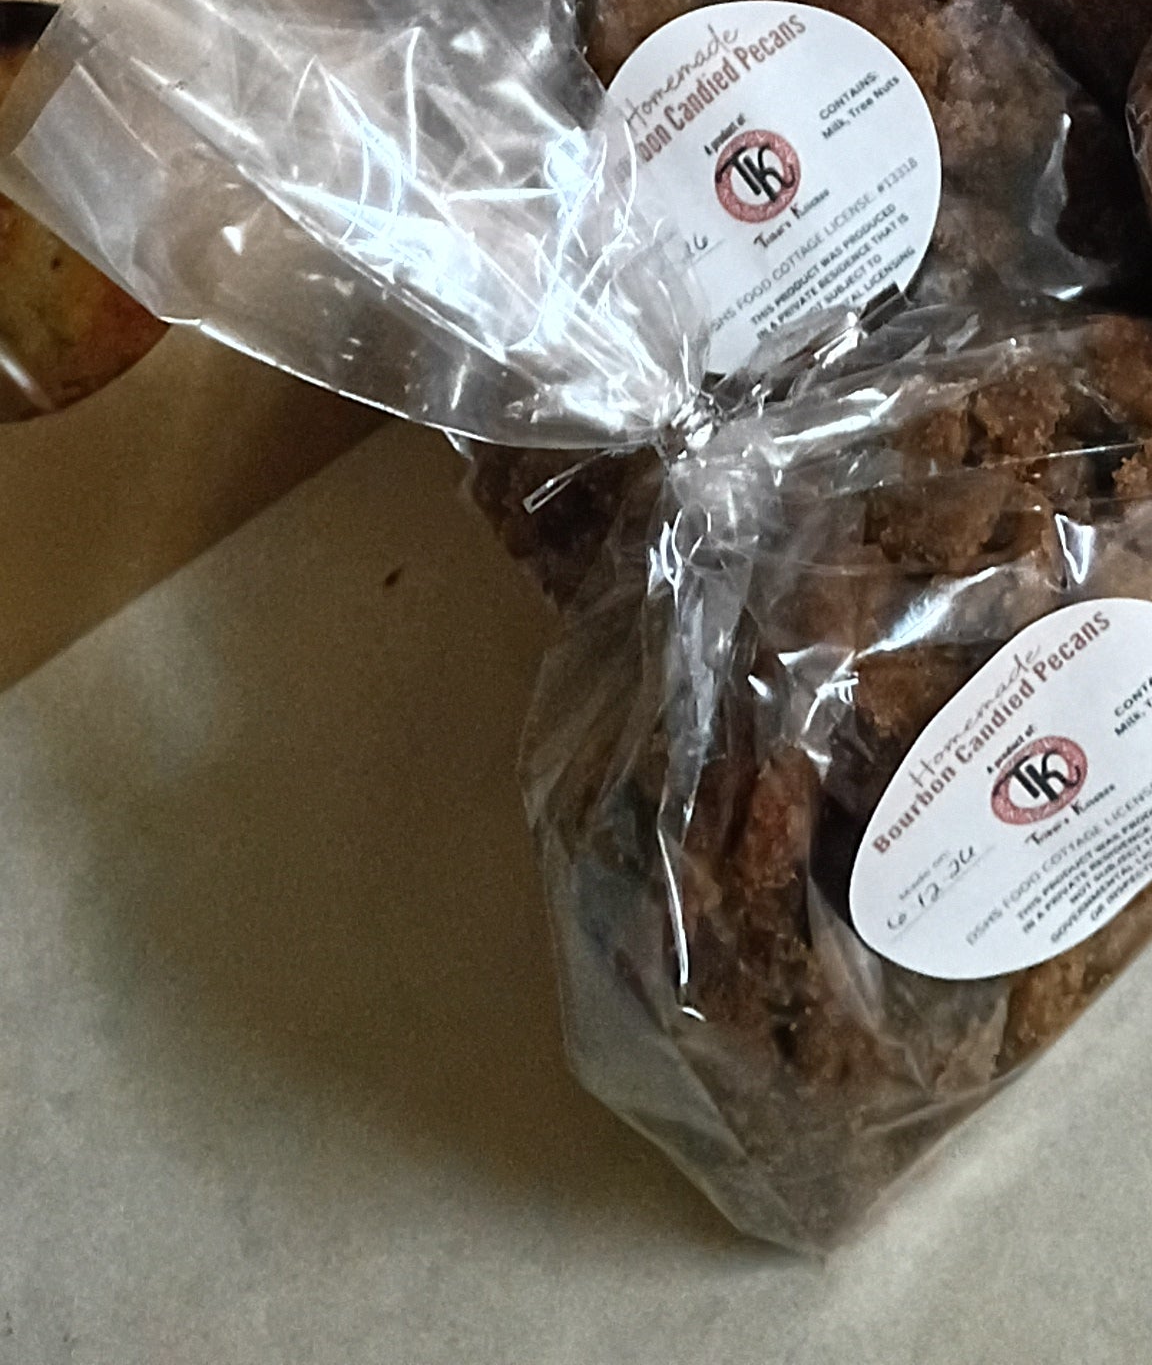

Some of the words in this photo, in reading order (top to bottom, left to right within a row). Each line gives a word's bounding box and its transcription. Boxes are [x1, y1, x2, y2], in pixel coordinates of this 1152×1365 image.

[619, 24, 738, 135] Homemade
[663, 56, 740, 132] Candied
[732, 14, 806, 71] Pecans
[821, 117, 851, 141] Milk,
[847, 95, 875, 120] Tree
[873, 73, 901, 100] Nuts
[714, 145, 795, 202] TK
[710, 305, 737, 334] SHS
[736, 279, 772, 310] FOOD
[771, 234, 825, 282] COTTAGE
[775, 264, 821, 308] PRODUCT
[820, 246, 844, 268] WAS
[843, 203, 896, 250] PRODUCED
[777, 286, 818, 323] PRIVATE
[818, 241, 872, 289] RESIDENCE
[871, 220, 900, 246] THAT
[898, 212, 910, 226] IS
[825, 267, 867, 304] SUBJECT
[866, 253, 883, 269] TO
[864, 245, 916, 292] LICENSING
[872, 765, 957, 855] Bourbon
[954, 677, 1036, 765] Candied
[1033, 611, 1111, 683] Pecans
[908, 645, 1041, 788] Homemade
[992, 749, 1082, 802] TK
